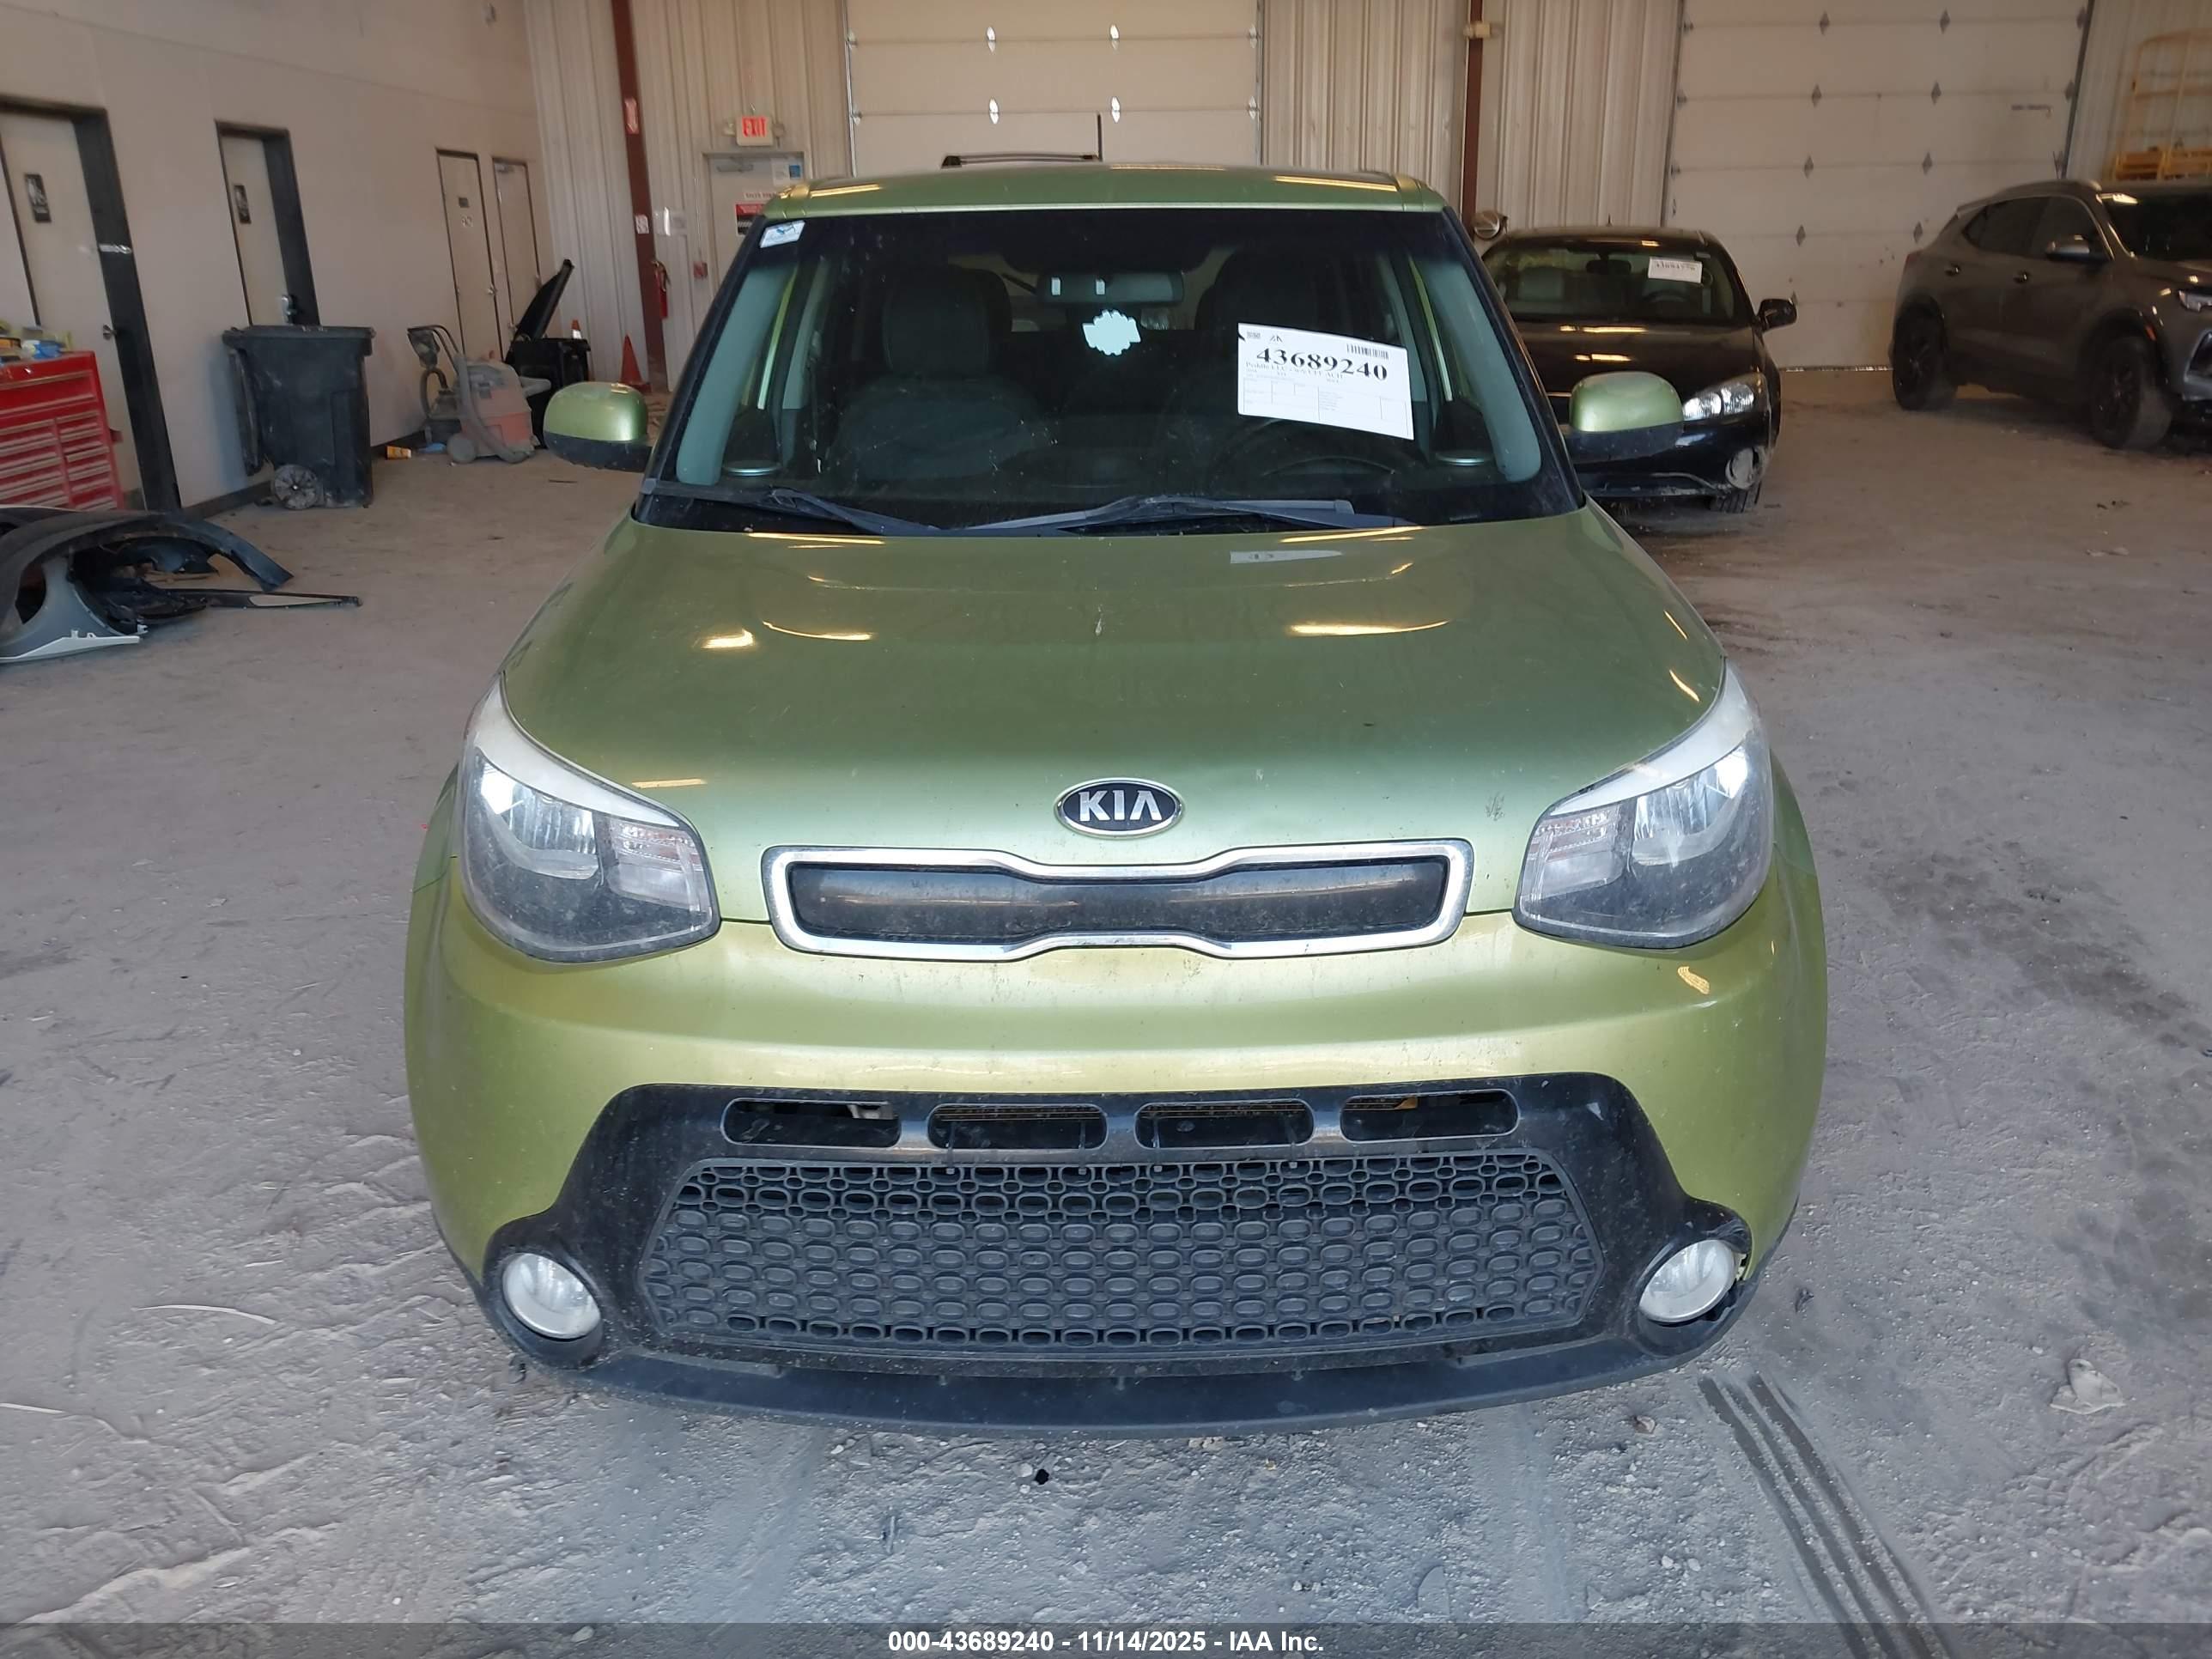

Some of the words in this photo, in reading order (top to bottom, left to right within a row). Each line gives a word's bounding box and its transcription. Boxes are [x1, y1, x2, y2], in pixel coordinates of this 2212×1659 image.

[742, 116, 767, 137] EXIT
[1256, 348, 1388, 380] 43689240
[1079, 790, 1163, 822] KIA
